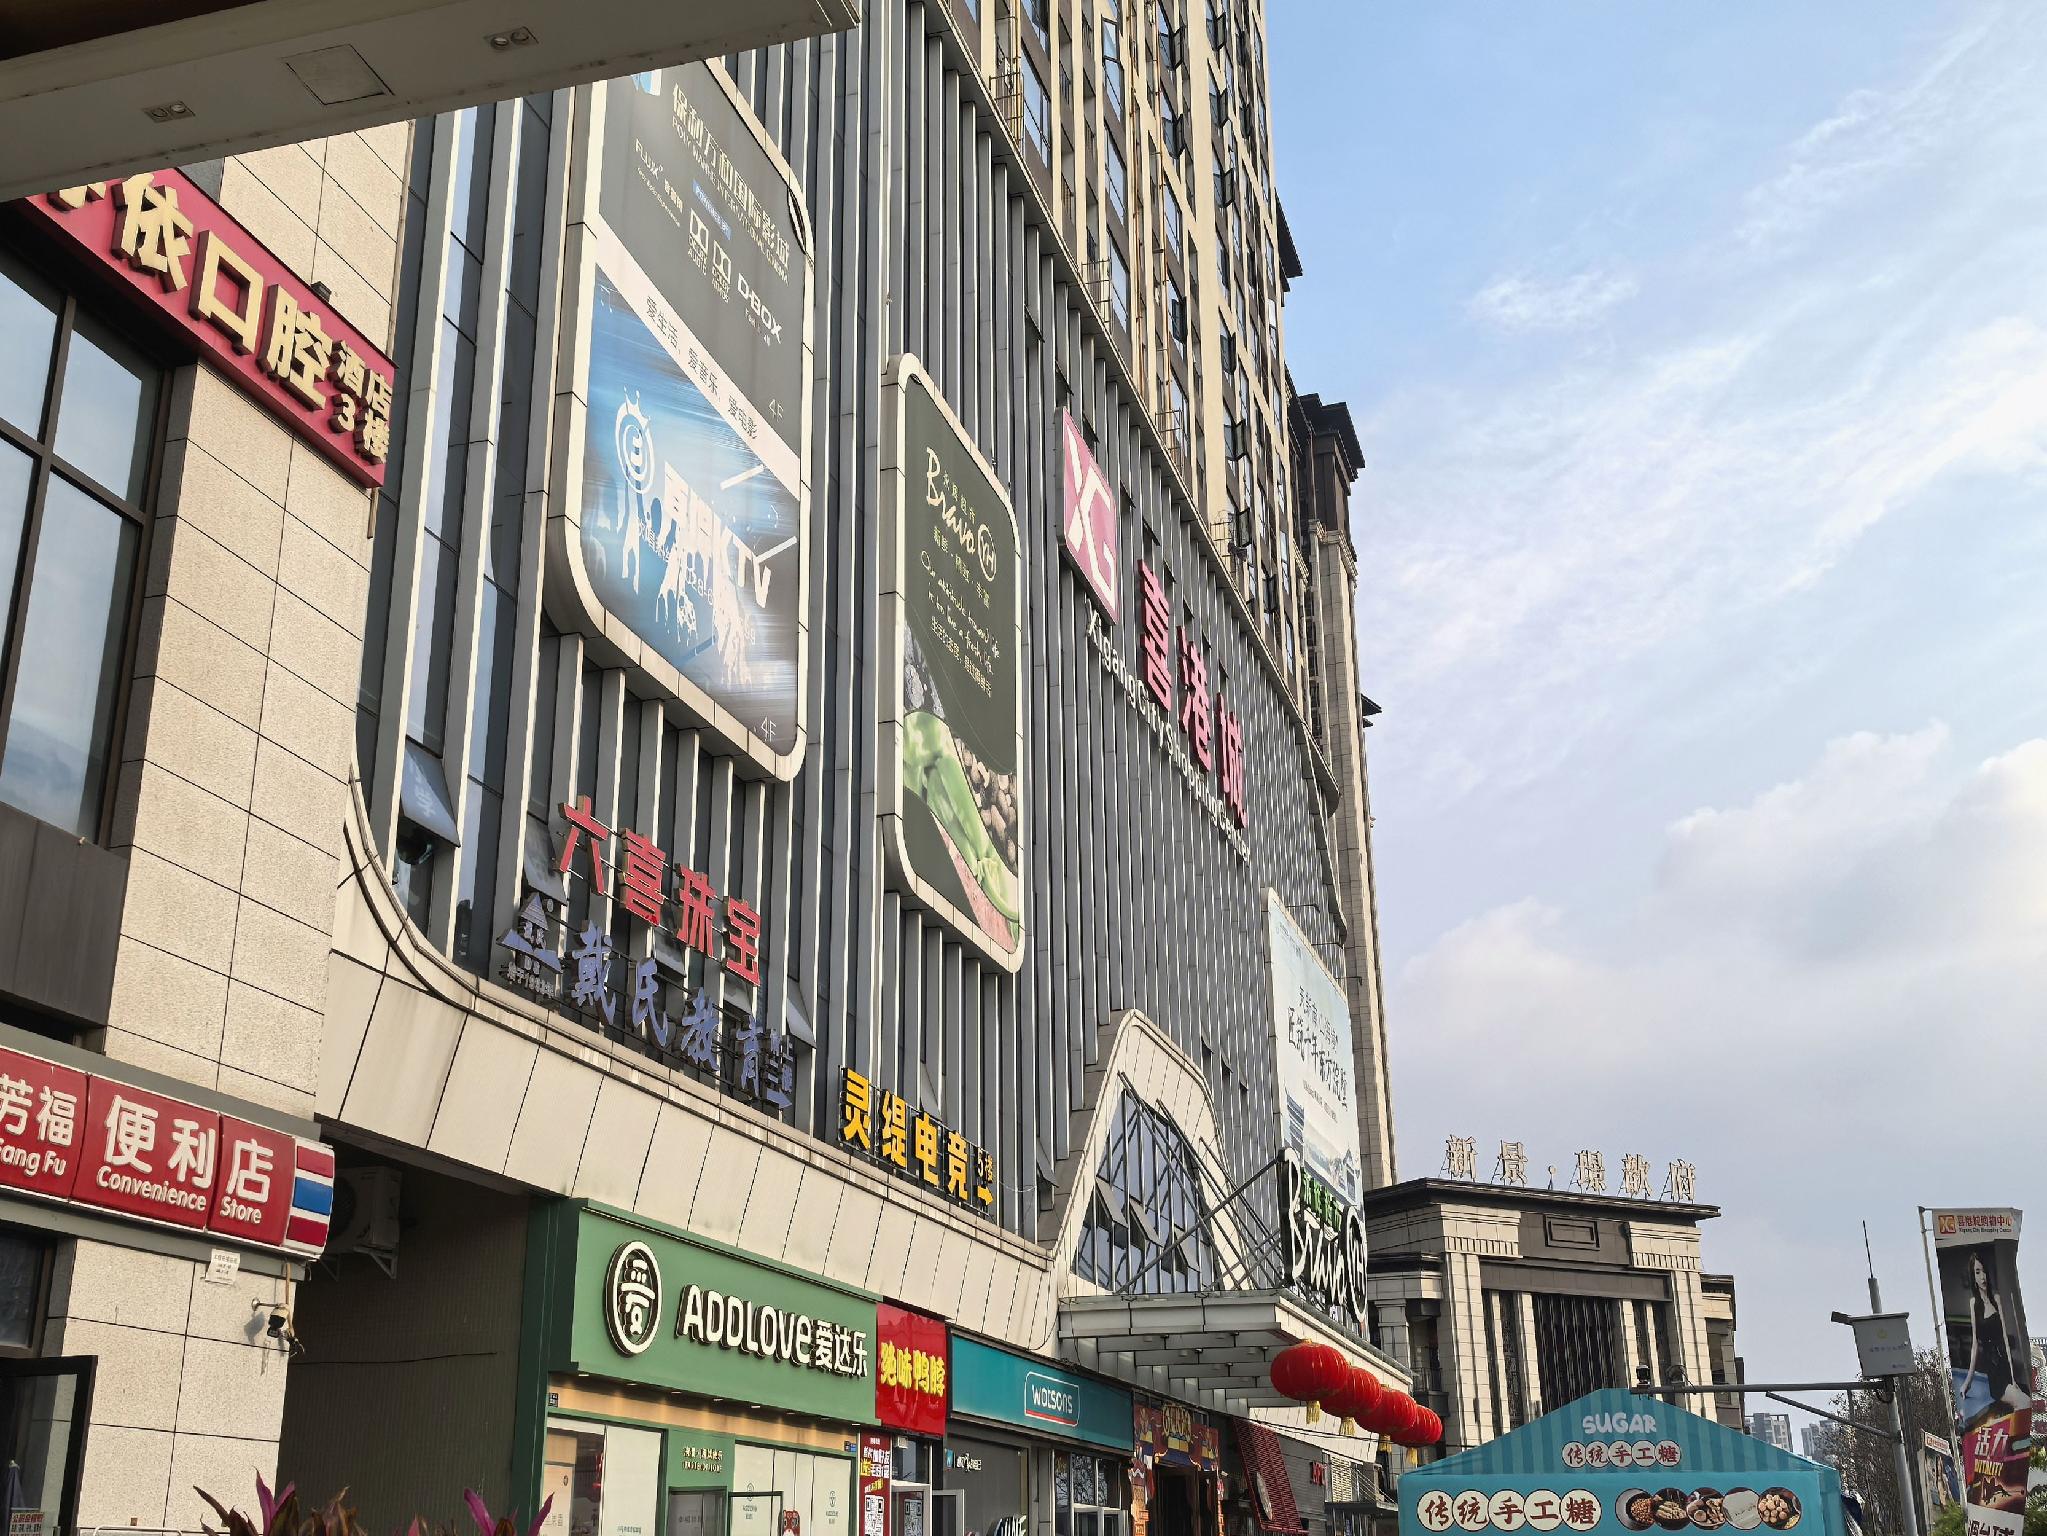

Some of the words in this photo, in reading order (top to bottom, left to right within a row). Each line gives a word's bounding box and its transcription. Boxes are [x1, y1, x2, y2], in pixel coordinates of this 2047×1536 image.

[52, 172, 332, 412] 依口腔
[335, 341, 393, 417] 酒店
[337, 394, 391, 464] 3楼
[1138, 560, 1250, 829] 喜港城
[559, 795, 762, 986] 六喜珠宝
[103, 1094, 275, 1205] 便利店
[843, 1068, 968, 1201] 灵缇电竞
[42, 1151, 66, 1178] Fu
[96, 1165, 207, 1212] Convenience
[220, 1196, 263, 1225] Store
[813, 1318, 869, 1377] 爱达乐
[880, 1340, 946, 1399] 绝味鸭脖
[1566, 1444, 1680, 1464] 传统手工糖
[1582, 1411, 1657, 1435] SUGAR
[1975, 1426, 2009, 1458] 活力
[1424, 1496, 1596, 1526] 传统手工糖
